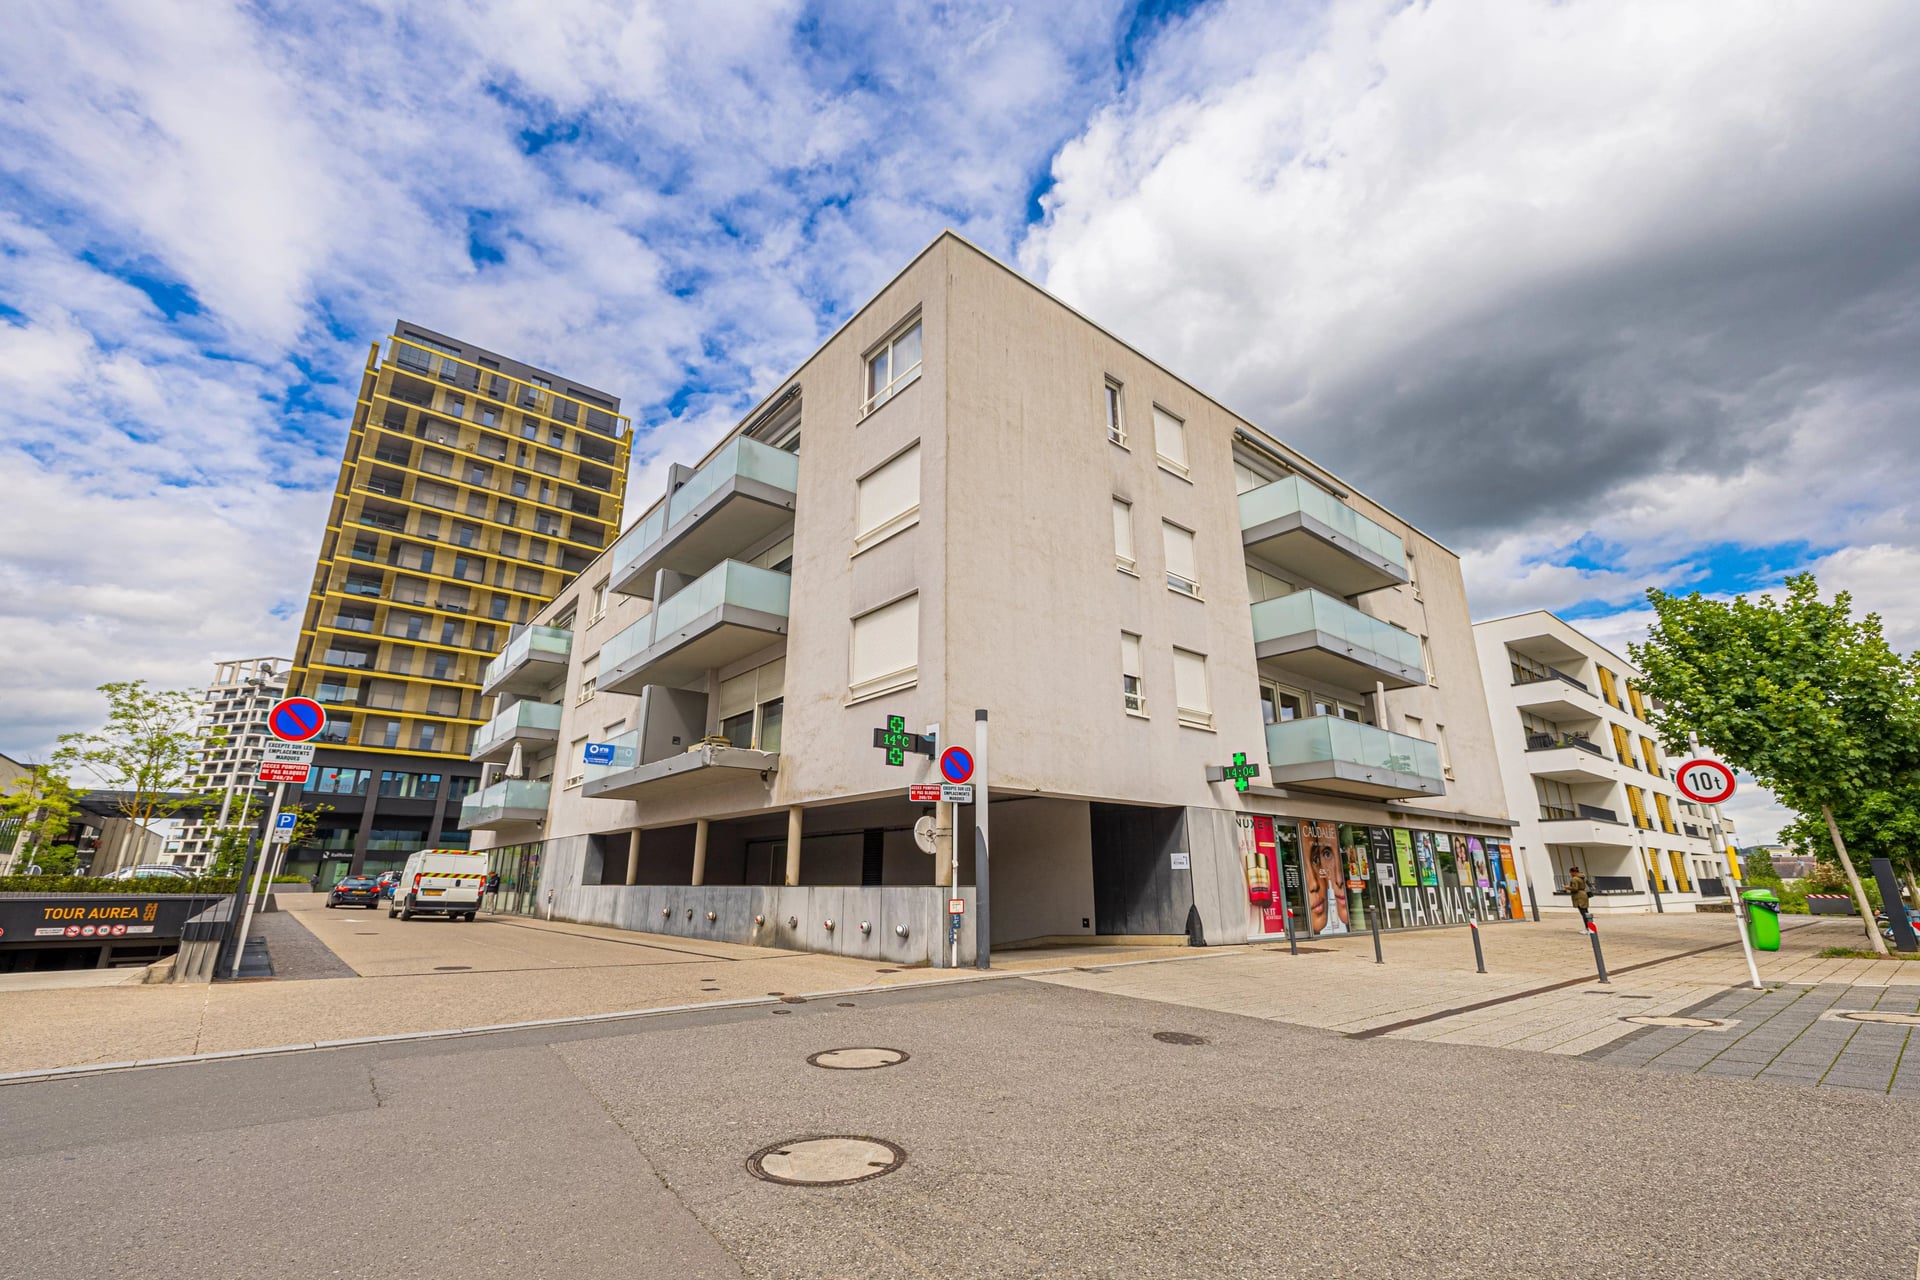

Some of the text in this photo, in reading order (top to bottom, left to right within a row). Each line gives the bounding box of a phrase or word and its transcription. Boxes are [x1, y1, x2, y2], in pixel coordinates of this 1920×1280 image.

[884, 734, 909, 748] 14°C
[268, 748, 310, 756] EMPLACEMENTS
[1225, 766, 1255, 778] 14:04
[280, 816, 291, 826] P
[1383, 884, 1495, 928] PHARMACIE
[44, 906, 139, 920] TOUR AUREA
